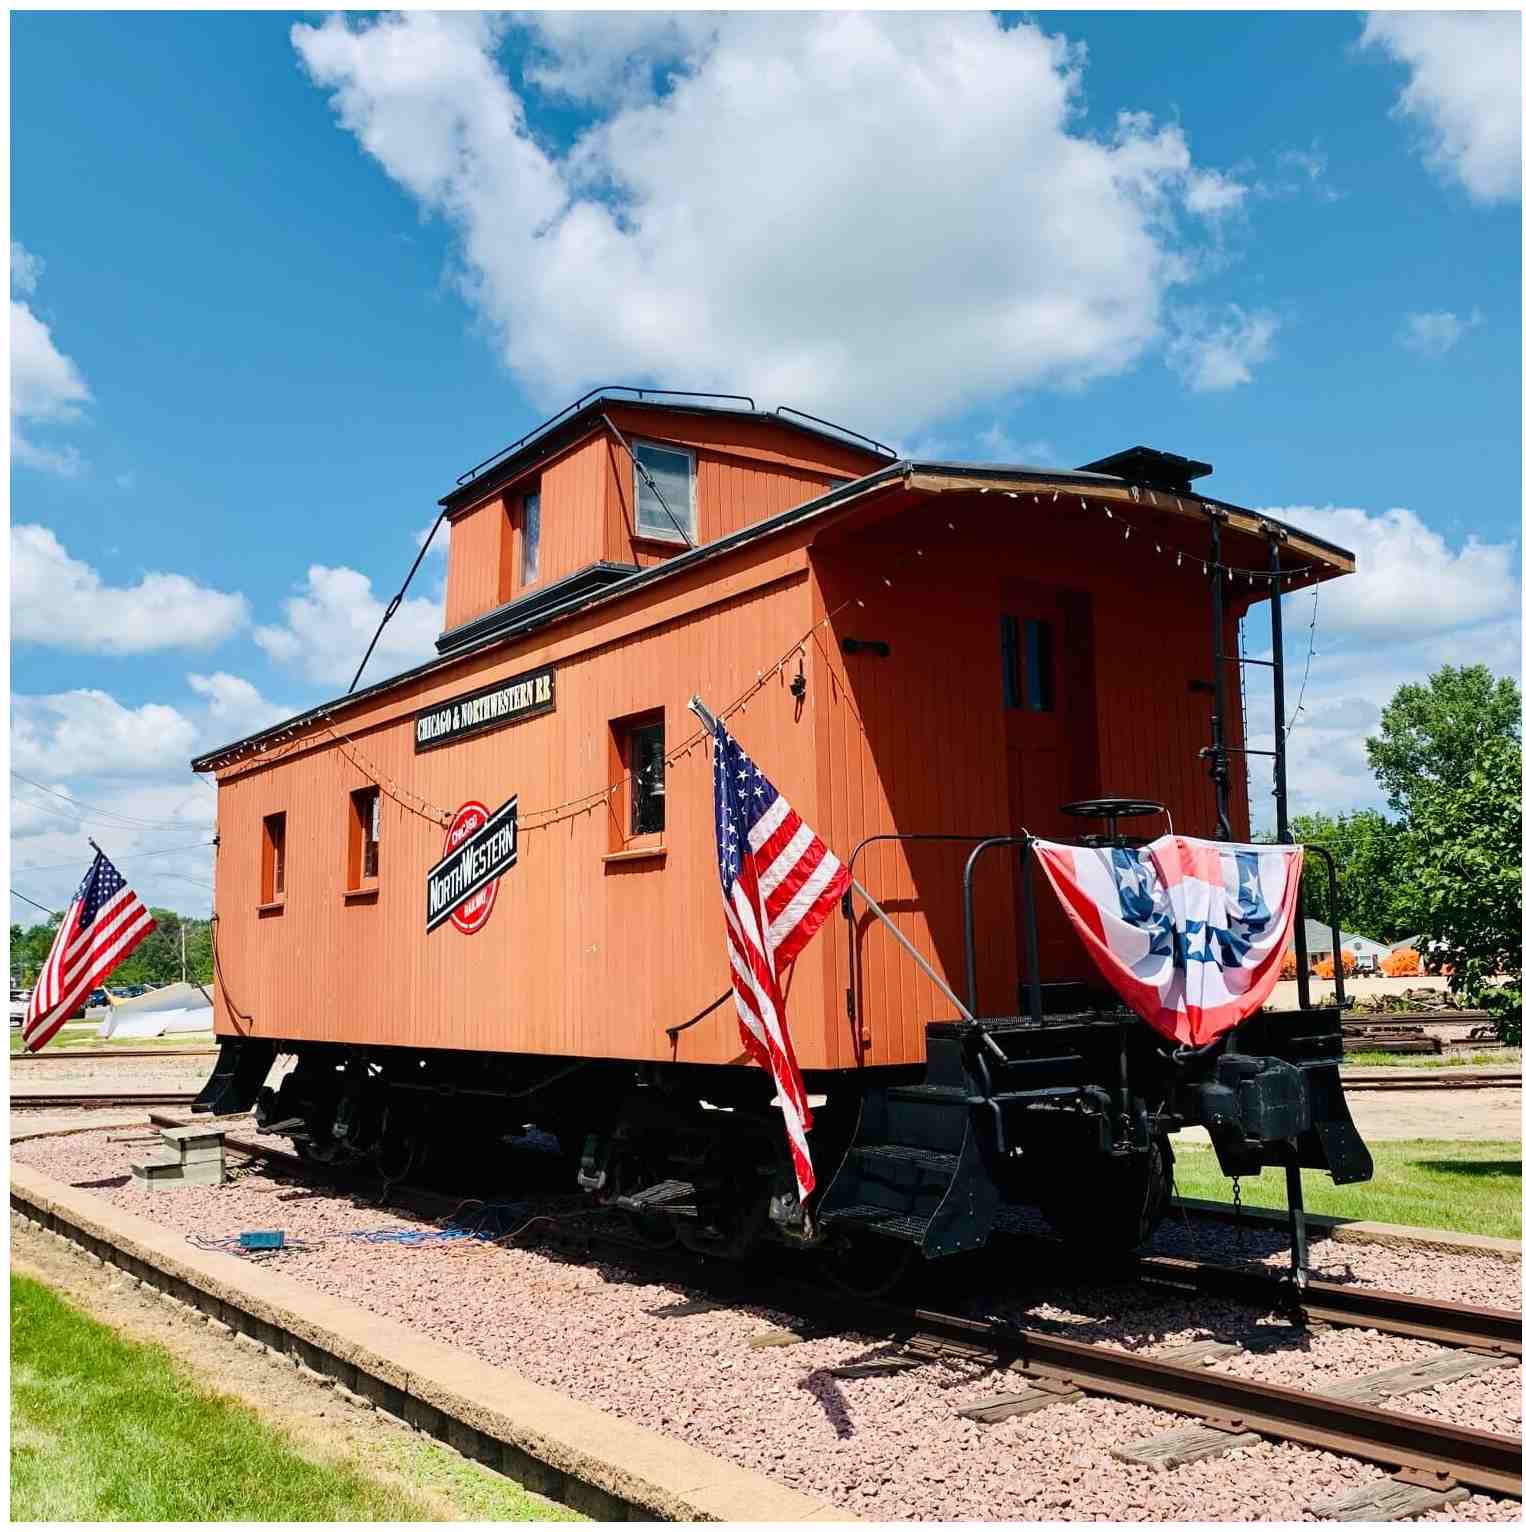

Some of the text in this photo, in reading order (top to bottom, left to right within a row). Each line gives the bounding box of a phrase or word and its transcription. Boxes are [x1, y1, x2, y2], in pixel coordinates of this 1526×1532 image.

[417, 675, 551, 742] CHICAGO & NORTHWESTERN RR
[451, 814, 478, 846] CHICAGO
[463, 888, 487, 918] RAILWAY
